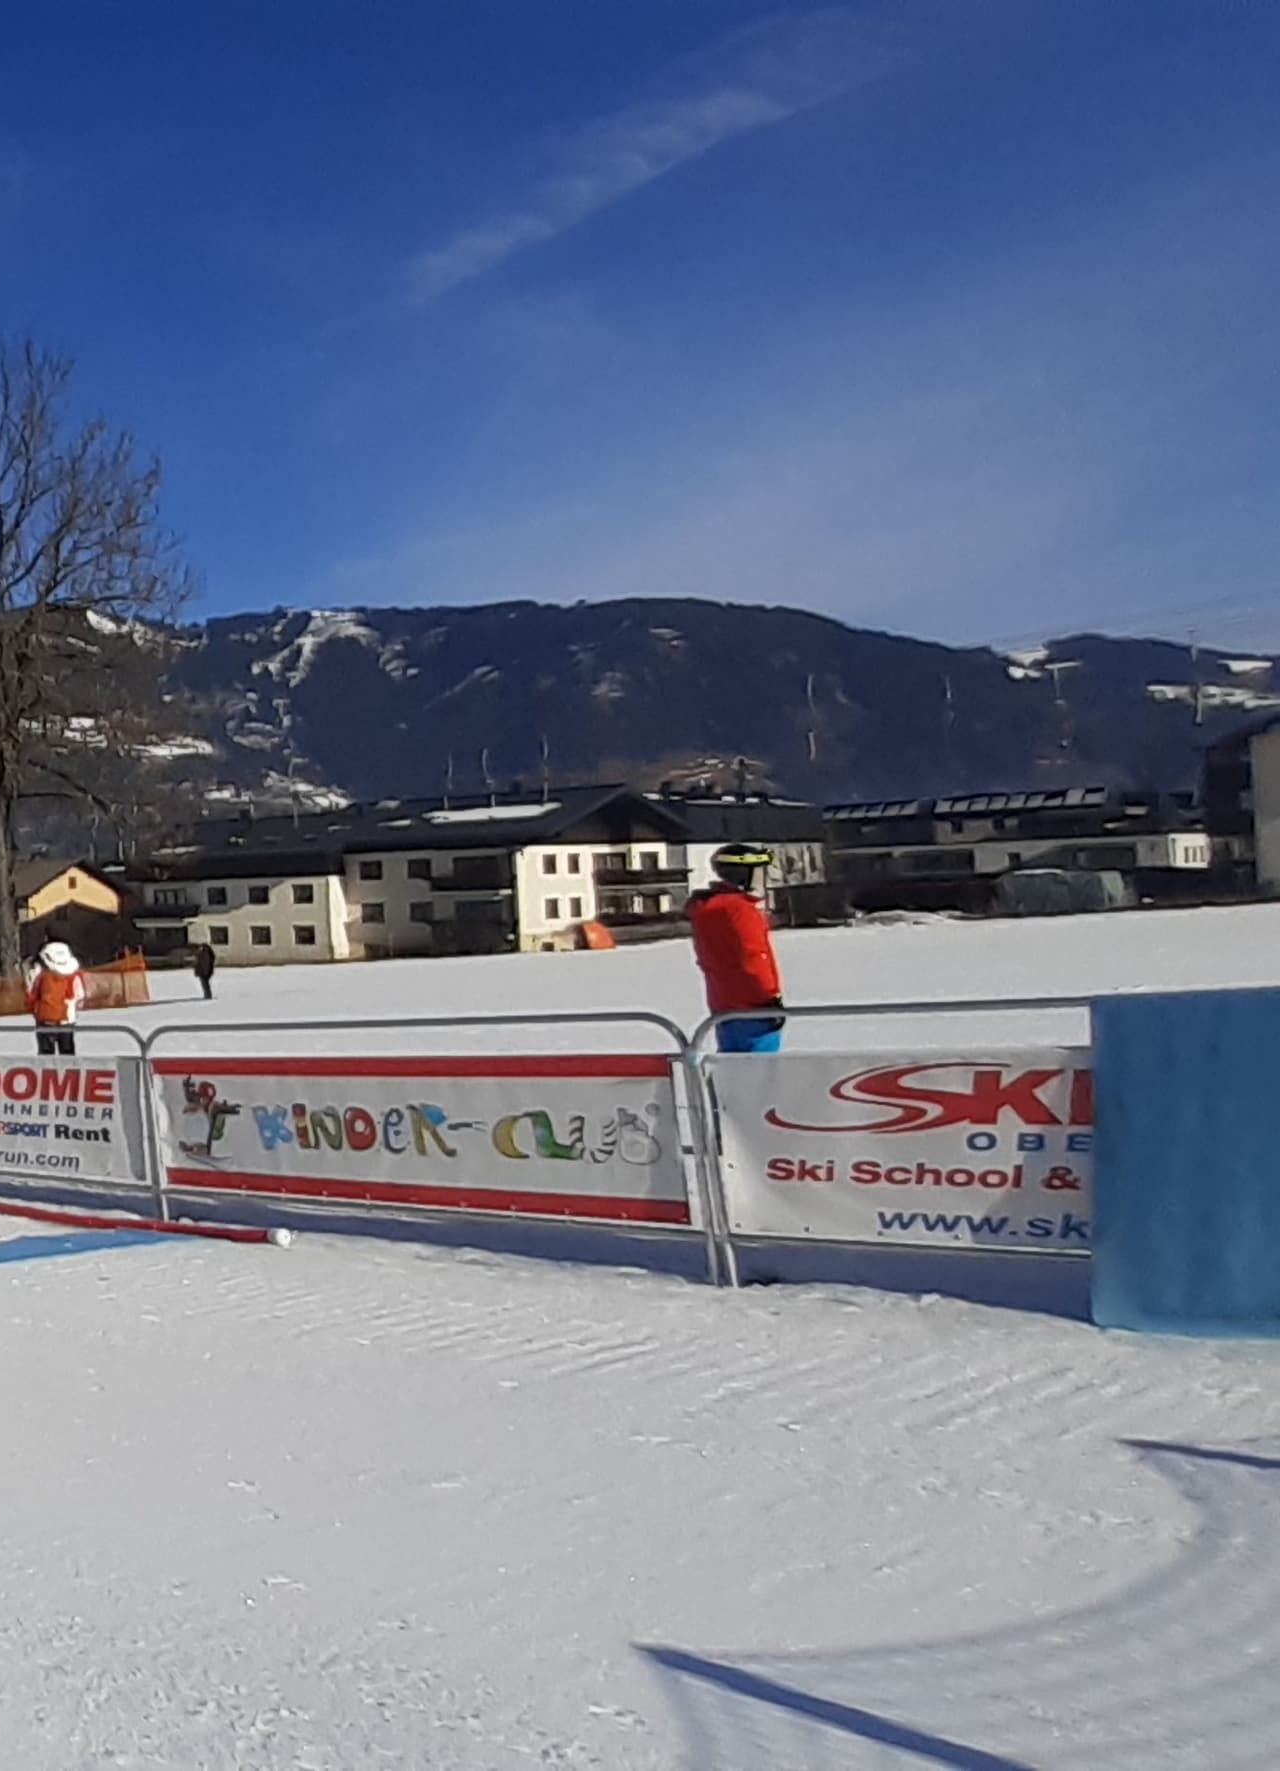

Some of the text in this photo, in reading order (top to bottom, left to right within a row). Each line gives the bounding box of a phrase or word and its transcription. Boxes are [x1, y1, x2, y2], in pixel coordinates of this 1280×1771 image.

[764, 1061, 1094, 1134] SKI
[54, 1124, 111, 1143] Rent
[767, 1158, 1081, 1190] Ski School &
